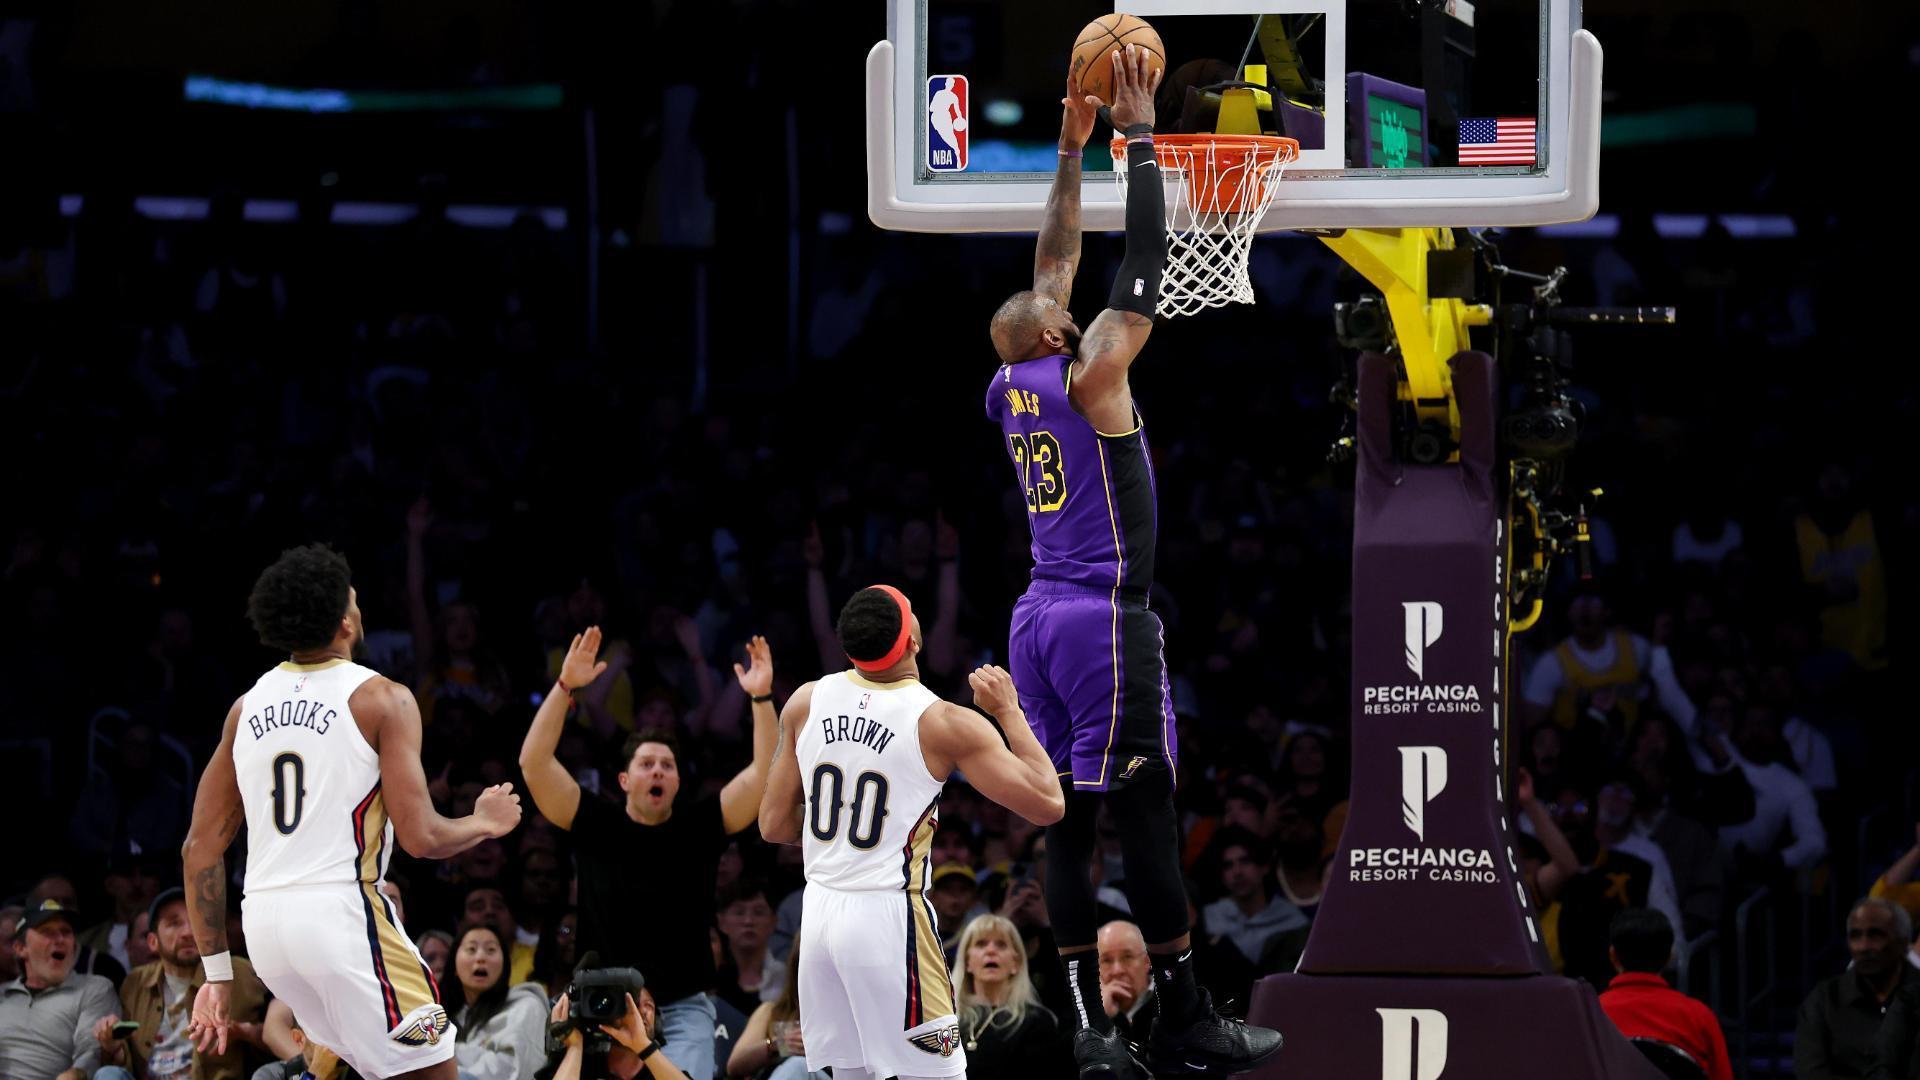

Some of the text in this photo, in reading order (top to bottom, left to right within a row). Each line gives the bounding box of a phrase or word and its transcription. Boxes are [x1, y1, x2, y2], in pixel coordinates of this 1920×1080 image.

[933, 149, 953, 166] NBA
[1008, 430, 1067, 513] 23
[1364, 685, 1480, 703] PECHANGA
[1364, 702, 1419, 715] RESORT
[248, 699, 337, 741] BROOKS
[822, 715, 895, 755] BROWN
[271, 751, 306, 837] 0
[809, 762, 890, 852] 00
[1350, 847, 1495, 868] PECHANGA
[1350, 868, 1419, 882] RESORT
